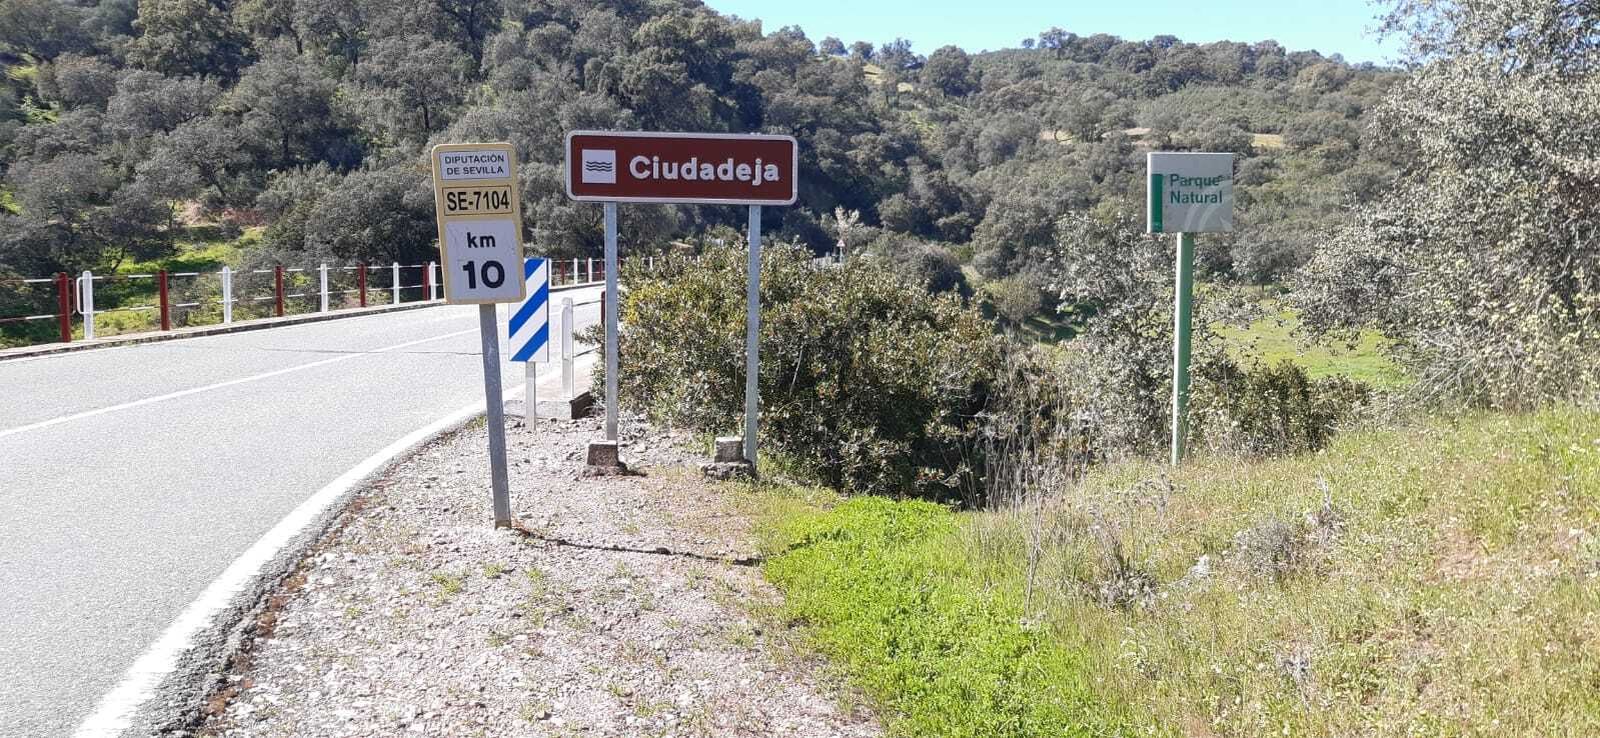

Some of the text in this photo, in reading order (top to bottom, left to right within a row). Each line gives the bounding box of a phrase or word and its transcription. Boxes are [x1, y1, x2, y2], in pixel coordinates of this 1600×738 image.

[444, 153, 505, 165] DIPUTACIÓN
[446, 165, 504, 176] DE SEVILLA
[629, 154, 780, 187] Ciudadeja
[1170, 173, 1221, 189] Parque
[446, 190, 510, 212] SE-7104
[1170, 190, 1223, 204] Natural
[467, 231, 496, 249] km
[462, 260, 505, 290] 10
